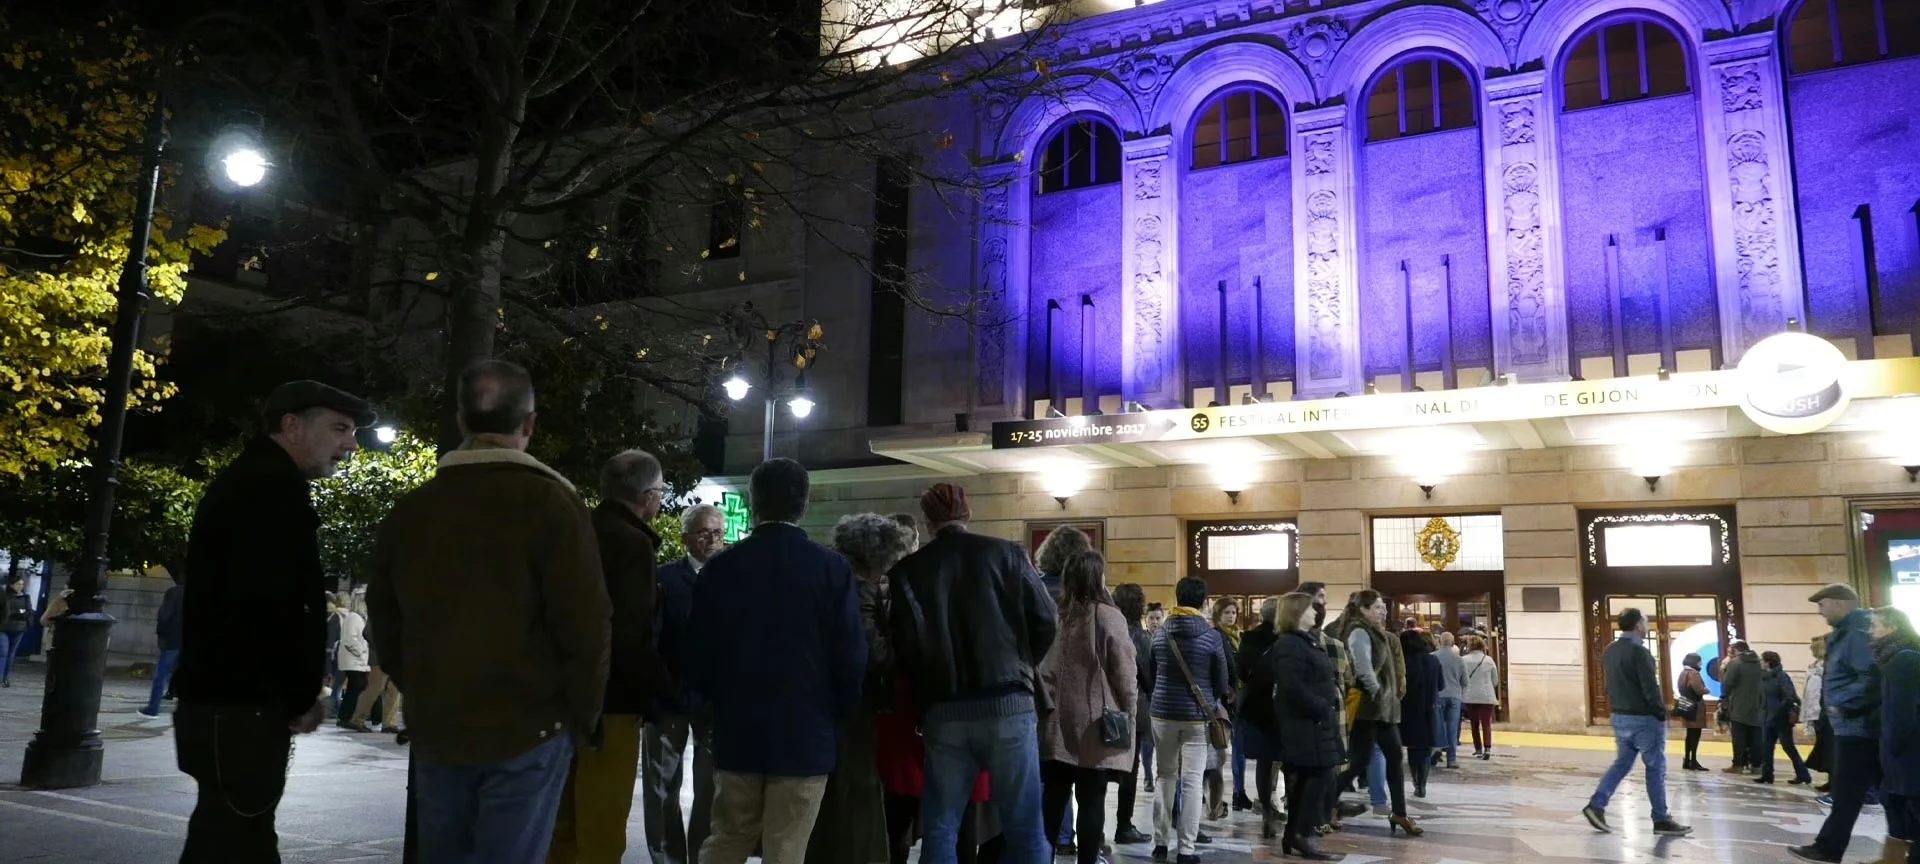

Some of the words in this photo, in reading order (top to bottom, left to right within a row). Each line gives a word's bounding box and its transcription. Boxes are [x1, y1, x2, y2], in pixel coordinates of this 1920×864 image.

[1193, 415, 1208, 429] 55
[1544, 393, 1569, 407] DE
[1782, 395, 1820, 412] USH
[1010, 429, 1043, 443] 17-25
[1045, 423, 1113, 440] noviembre
[1116, 422, 1146, 436] 2017
